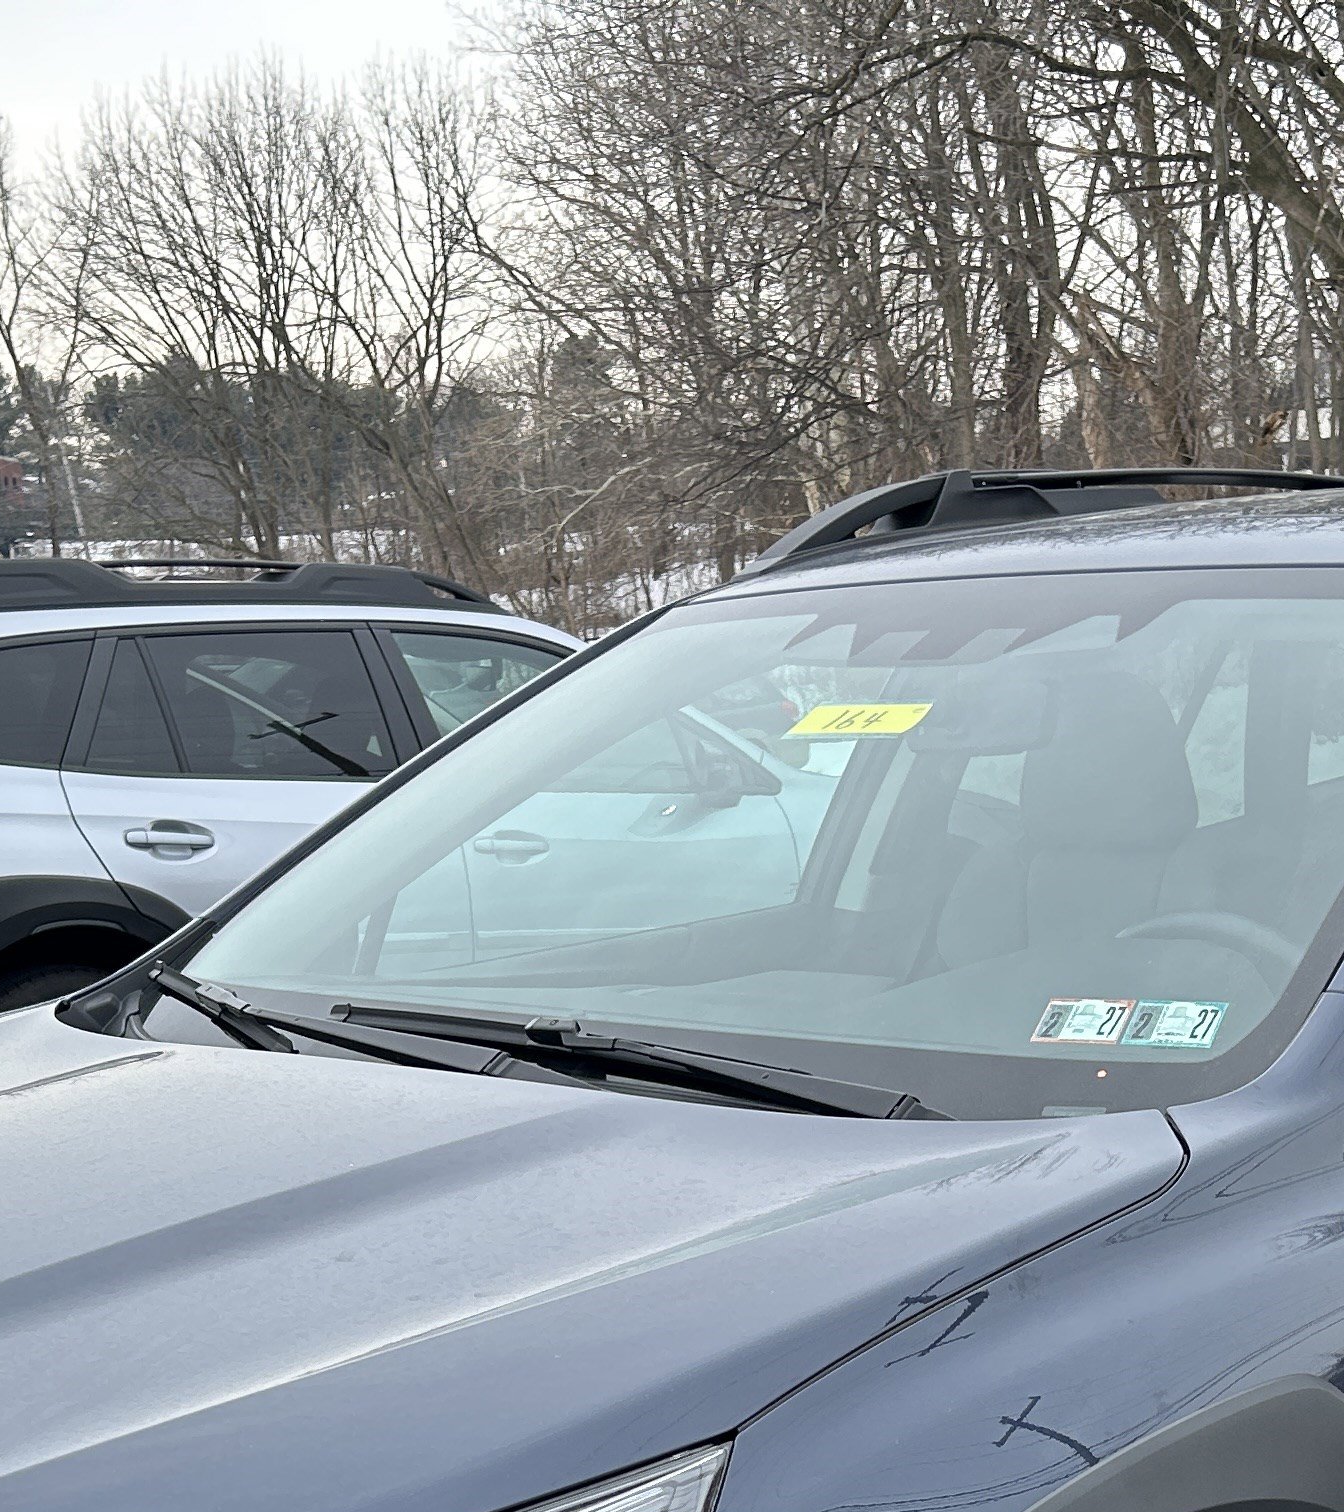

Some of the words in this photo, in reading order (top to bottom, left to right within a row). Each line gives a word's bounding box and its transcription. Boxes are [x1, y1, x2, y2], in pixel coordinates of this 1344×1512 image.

[821, 709, 889, 730] 164
[1096, 1006, 1127, 1038] 27
[1189, 1008, 1219, 1040] 27
